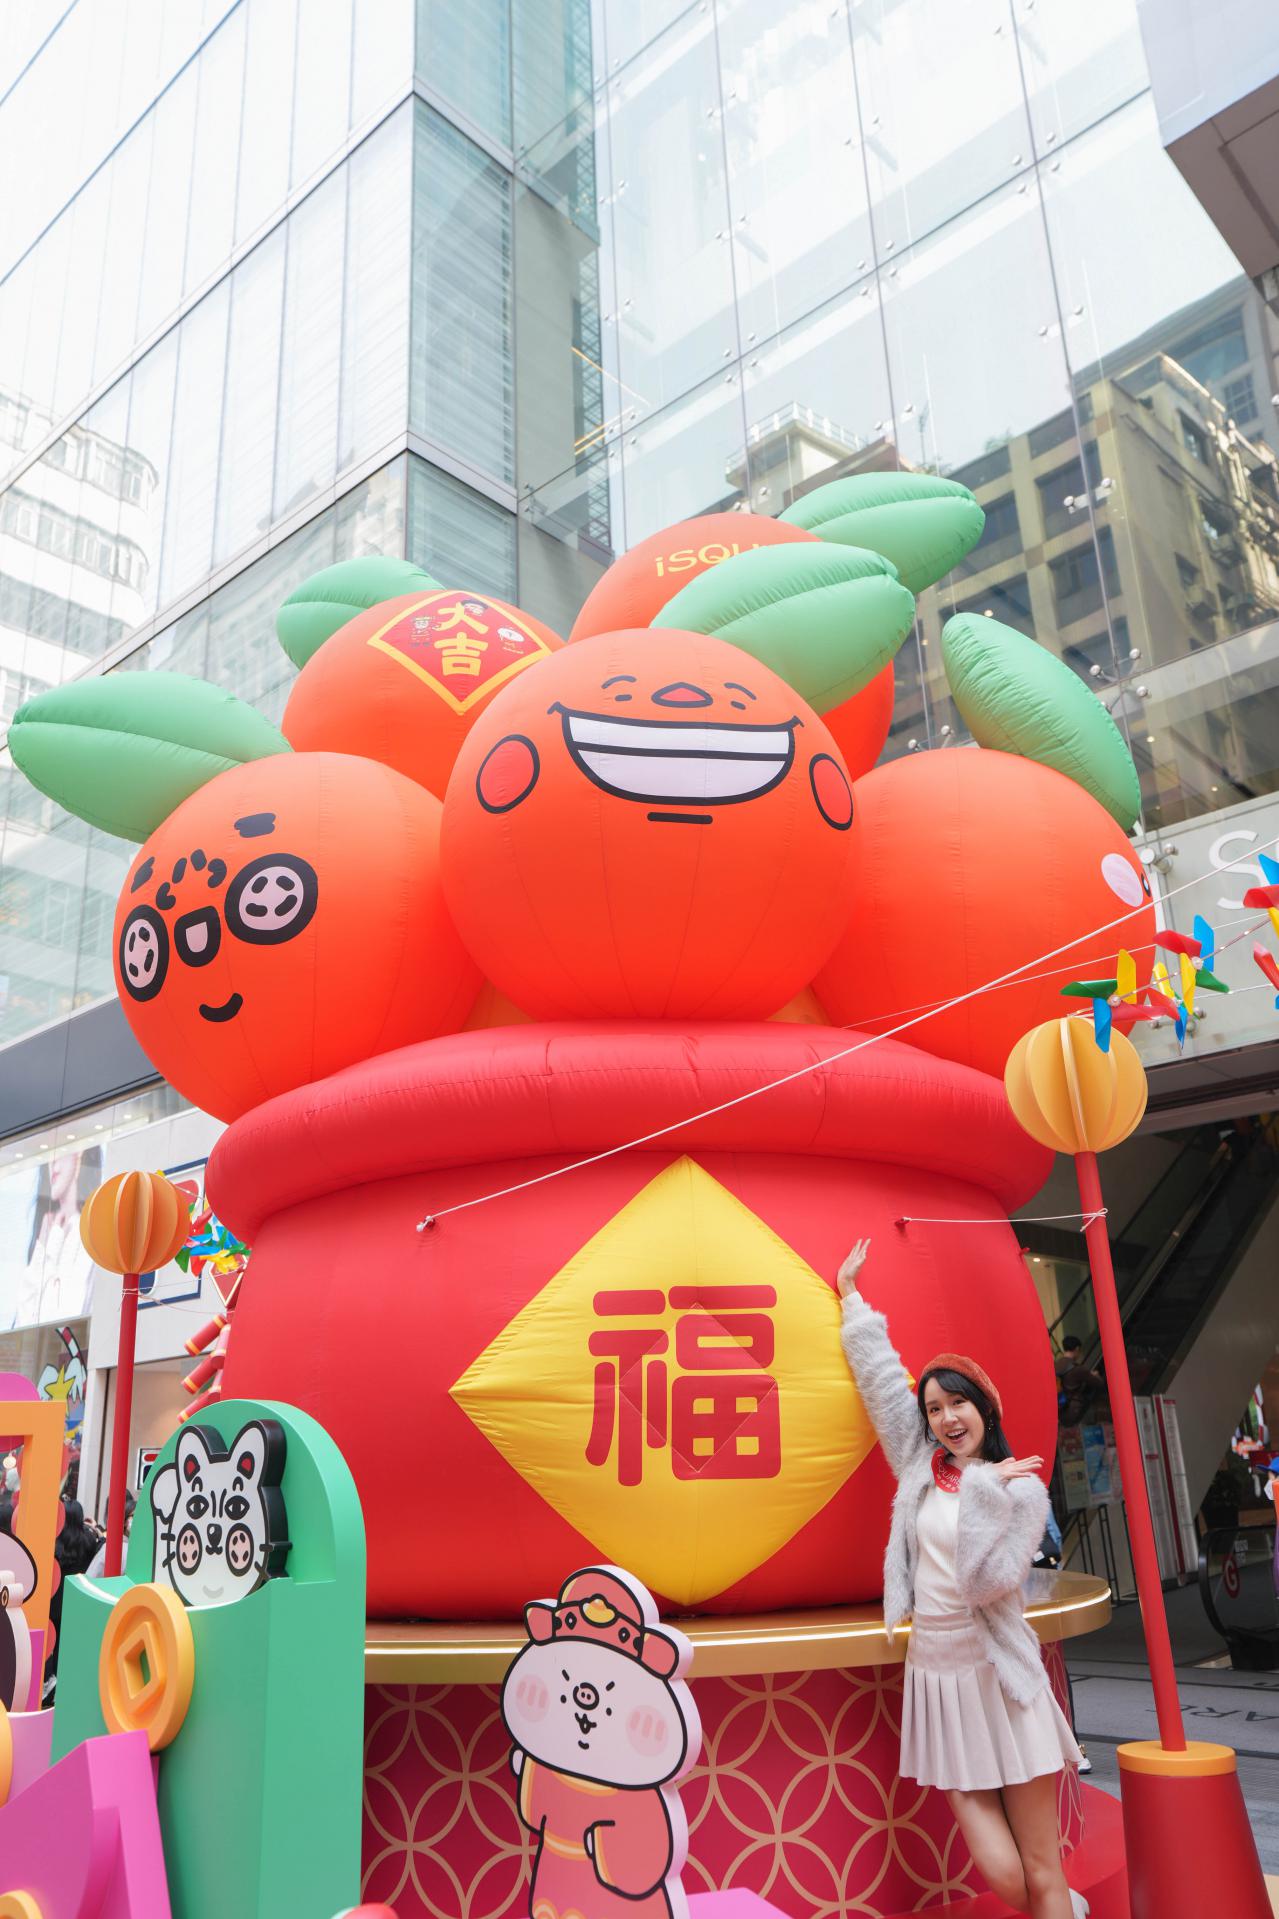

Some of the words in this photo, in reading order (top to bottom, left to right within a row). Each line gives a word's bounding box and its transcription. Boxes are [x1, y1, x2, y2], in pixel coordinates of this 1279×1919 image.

[433, 601, 489, 677] 大吉
[1209, 829, 1279, 910] S
[585, 1284, 781, 1487] 福
